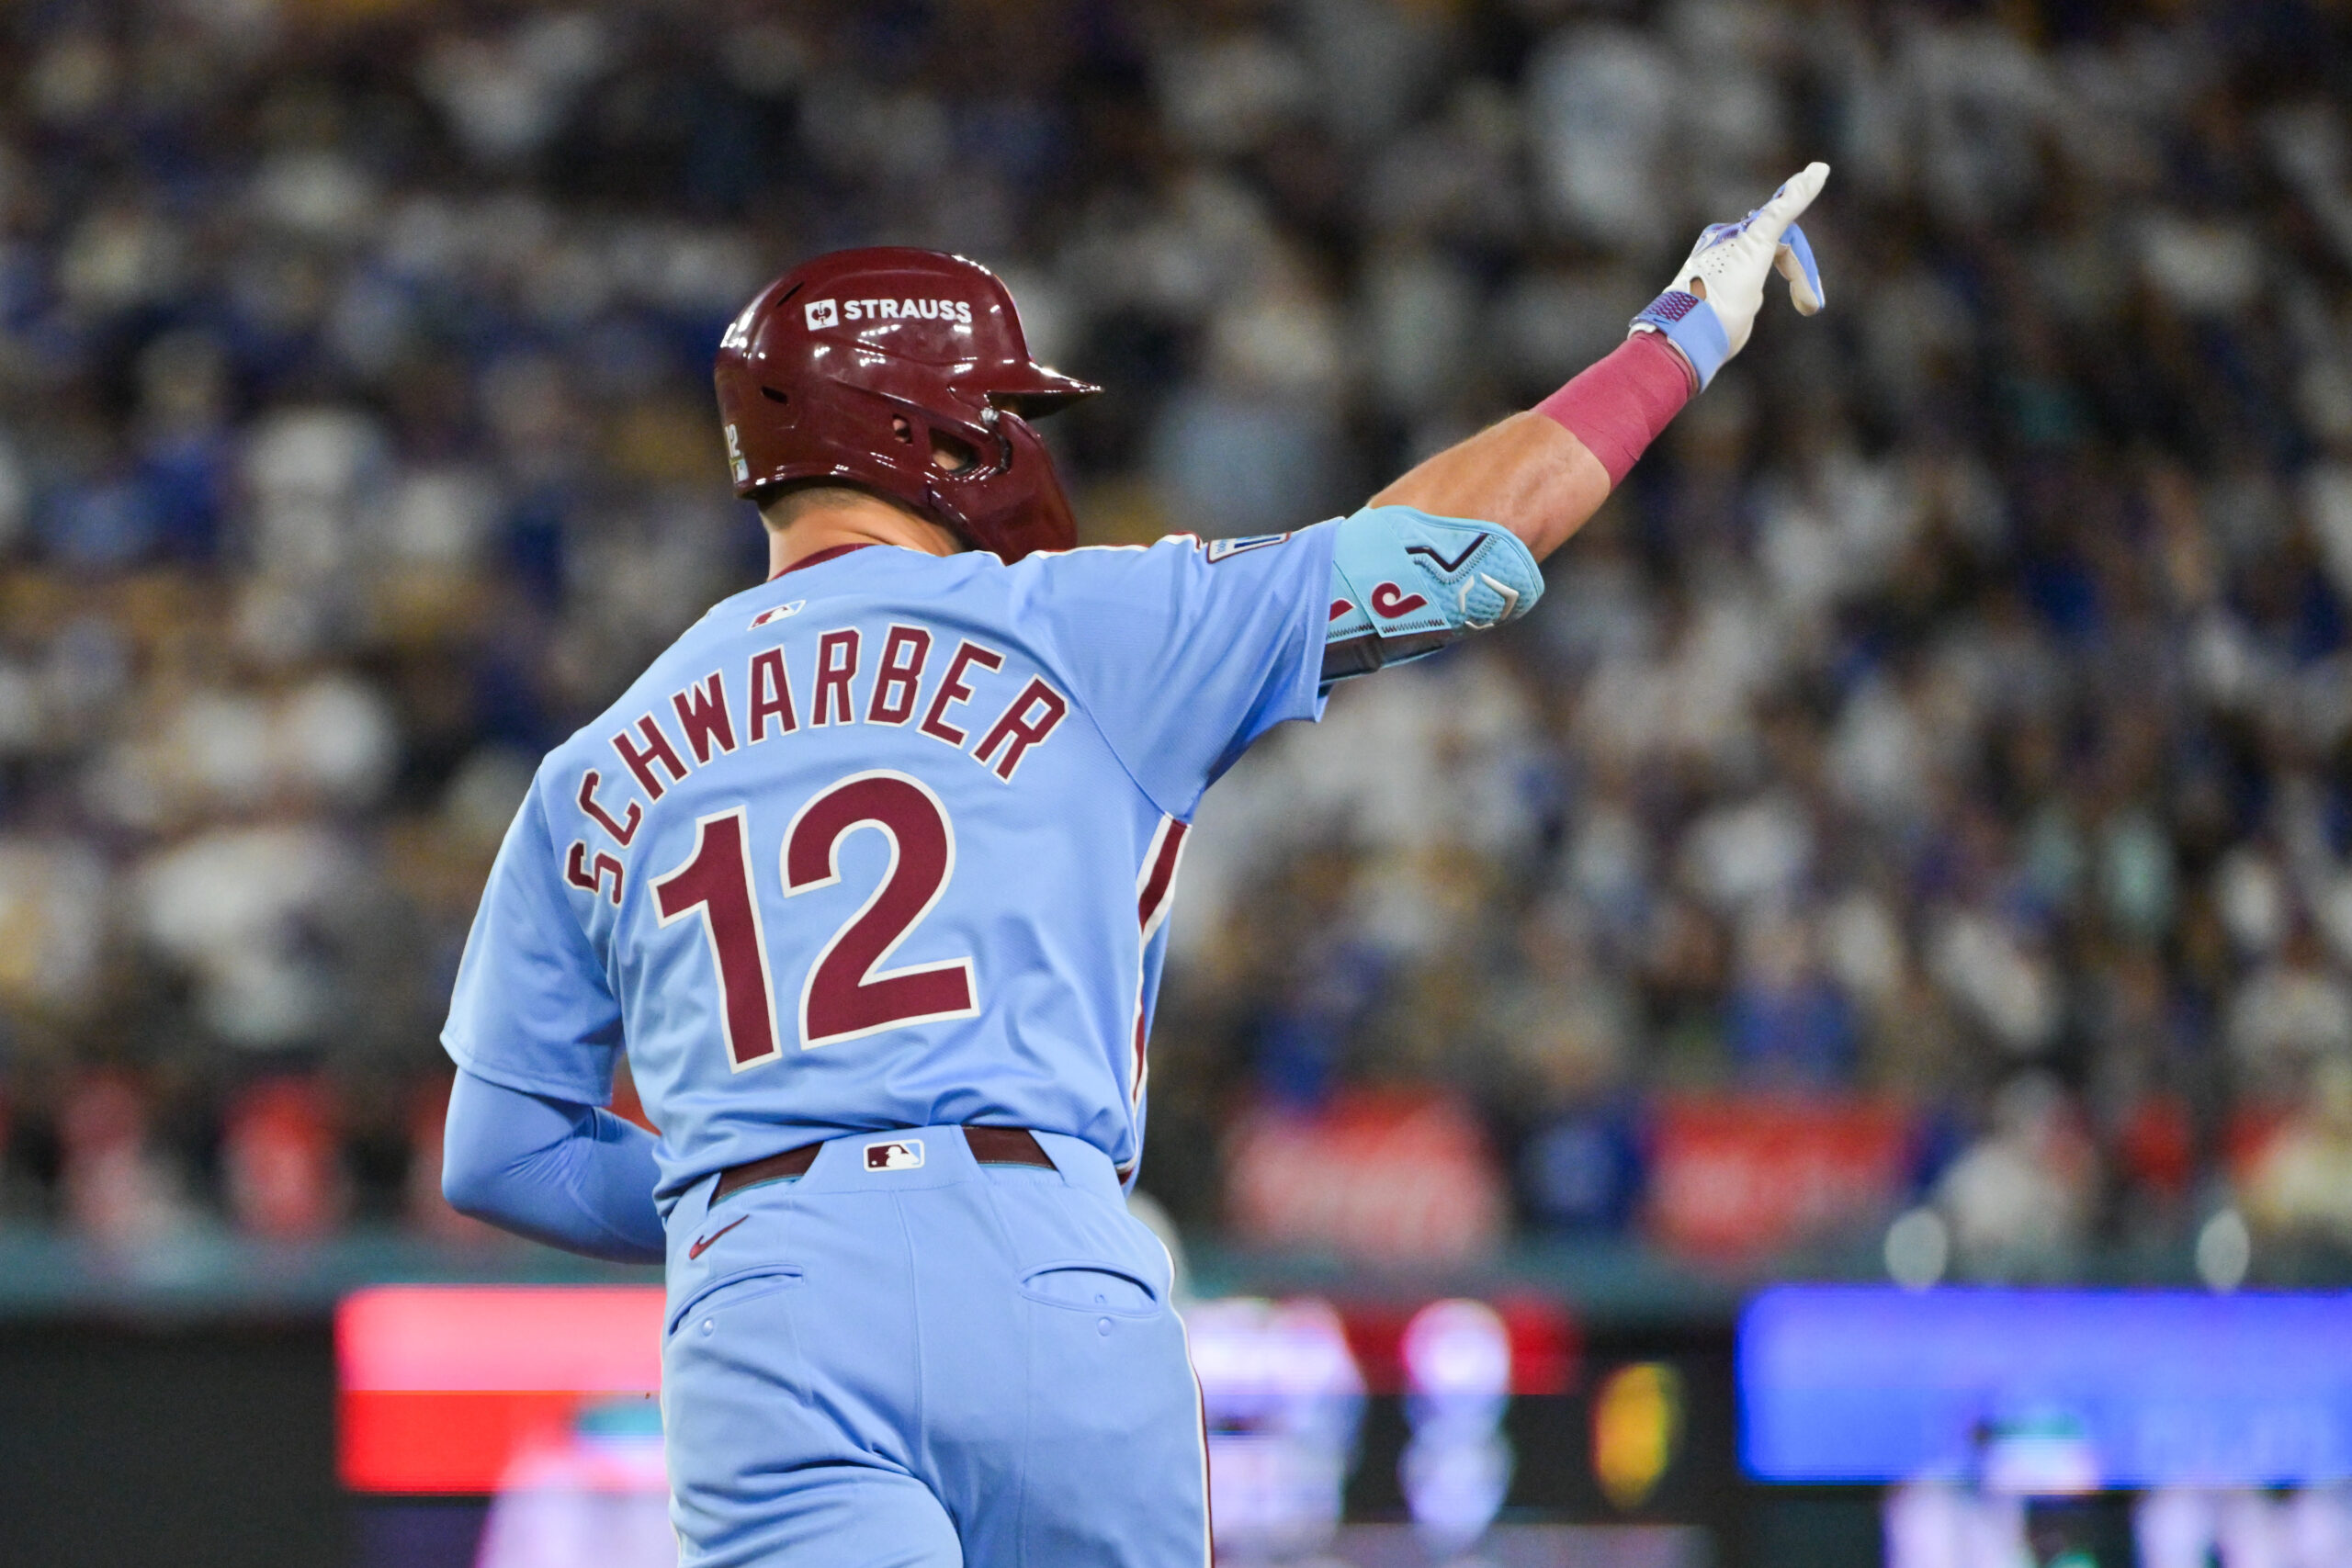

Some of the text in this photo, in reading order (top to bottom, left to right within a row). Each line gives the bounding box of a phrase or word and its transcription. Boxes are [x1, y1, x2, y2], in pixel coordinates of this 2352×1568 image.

[843, 299, 972, 323] STRAUSS
[563, 622, 1069, 907] SCHWARBER
[647, 768, 980, 1074] 12
